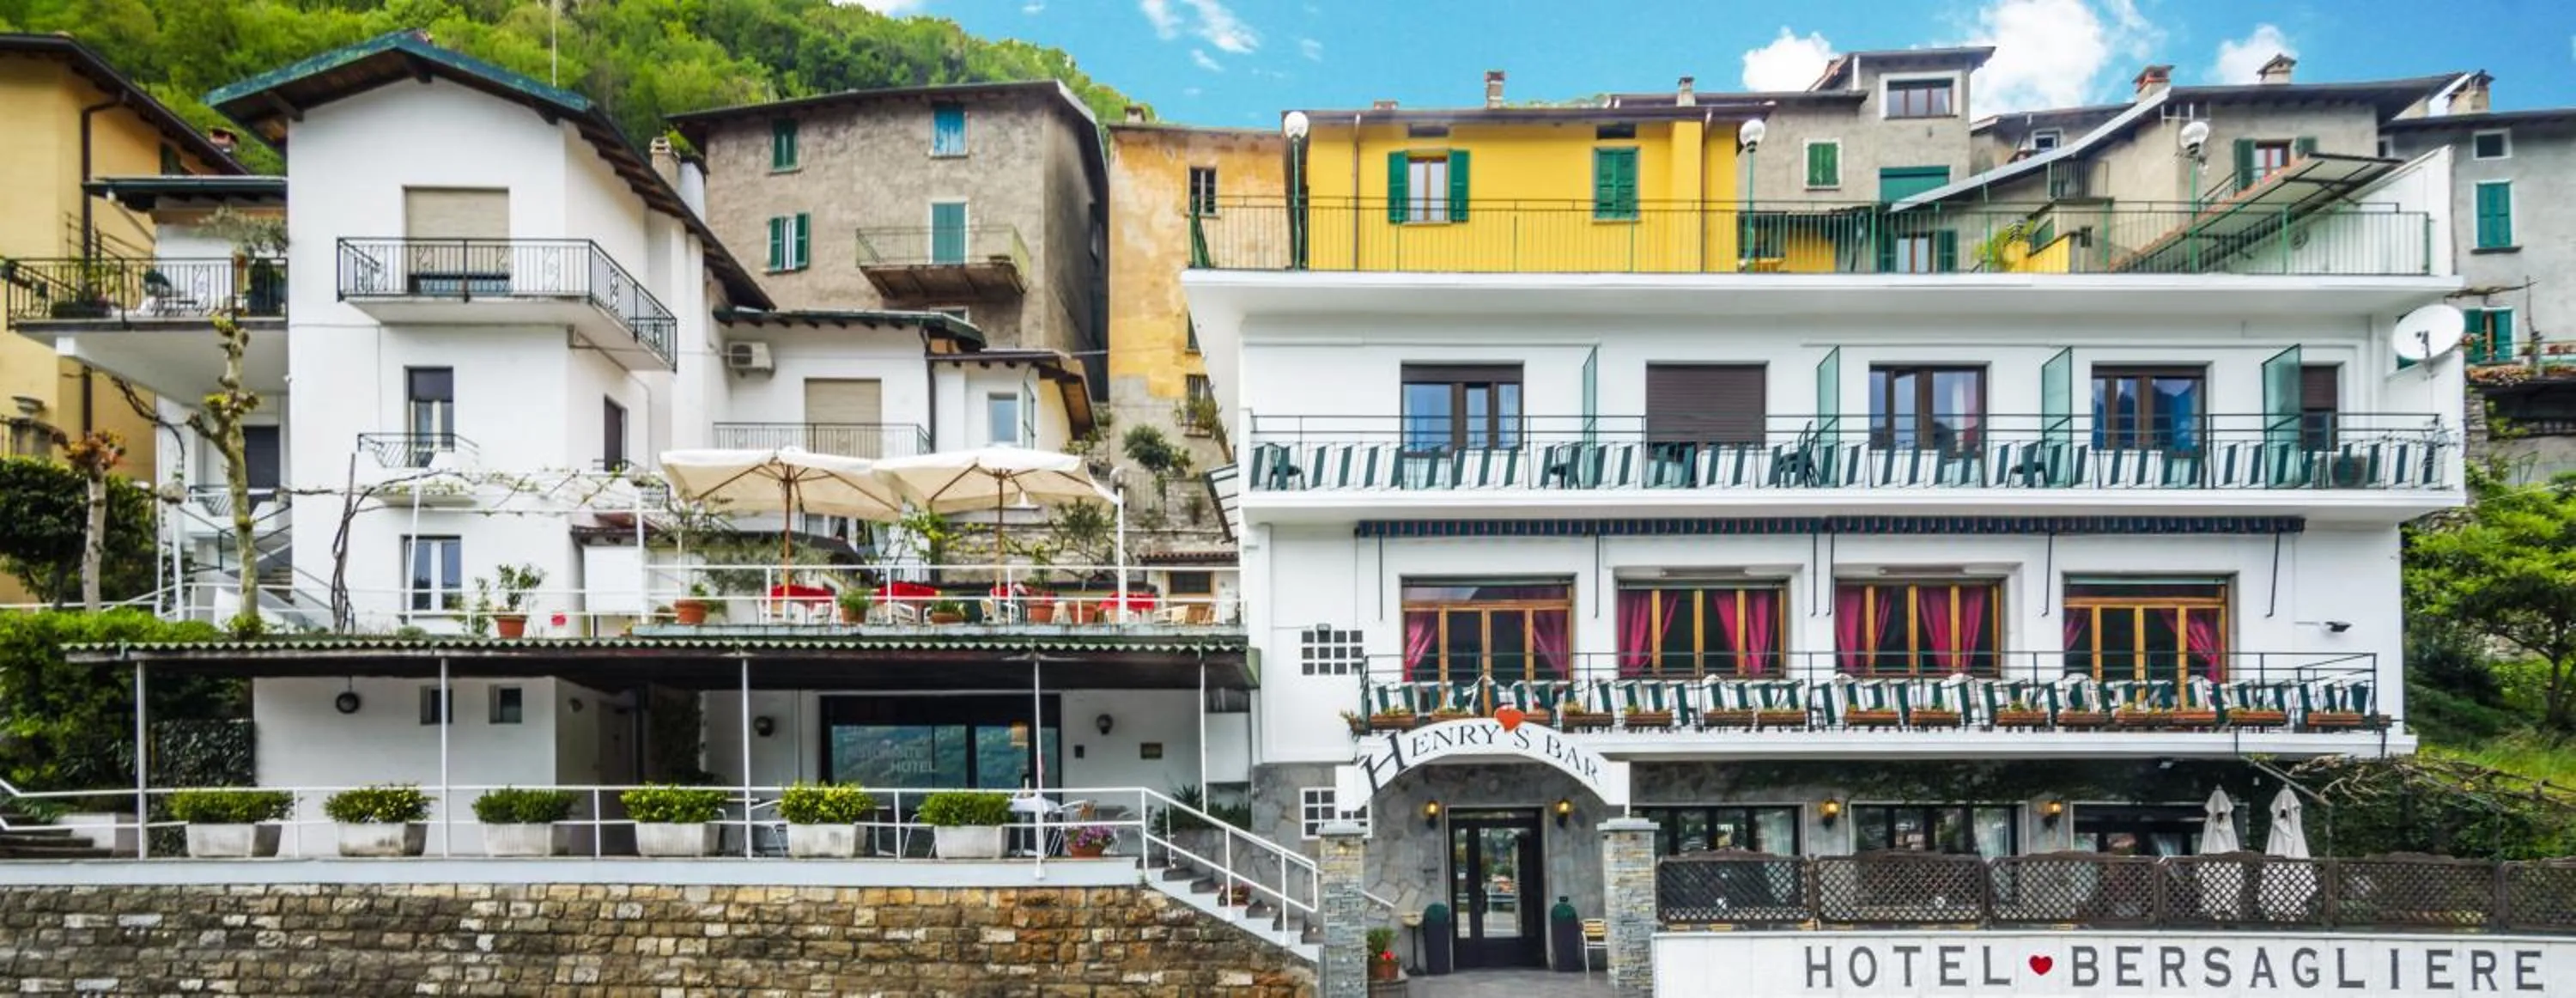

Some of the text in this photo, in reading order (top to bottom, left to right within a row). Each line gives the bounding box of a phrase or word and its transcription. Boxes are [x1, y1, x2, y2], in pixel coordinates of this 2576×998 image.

[890, 761, 936, 772] HOTEL
[1360, 725, 1599, 792] HENRYS BAR
[1805, 945, 2544, 991] HOTEL BERSAGLIERE
